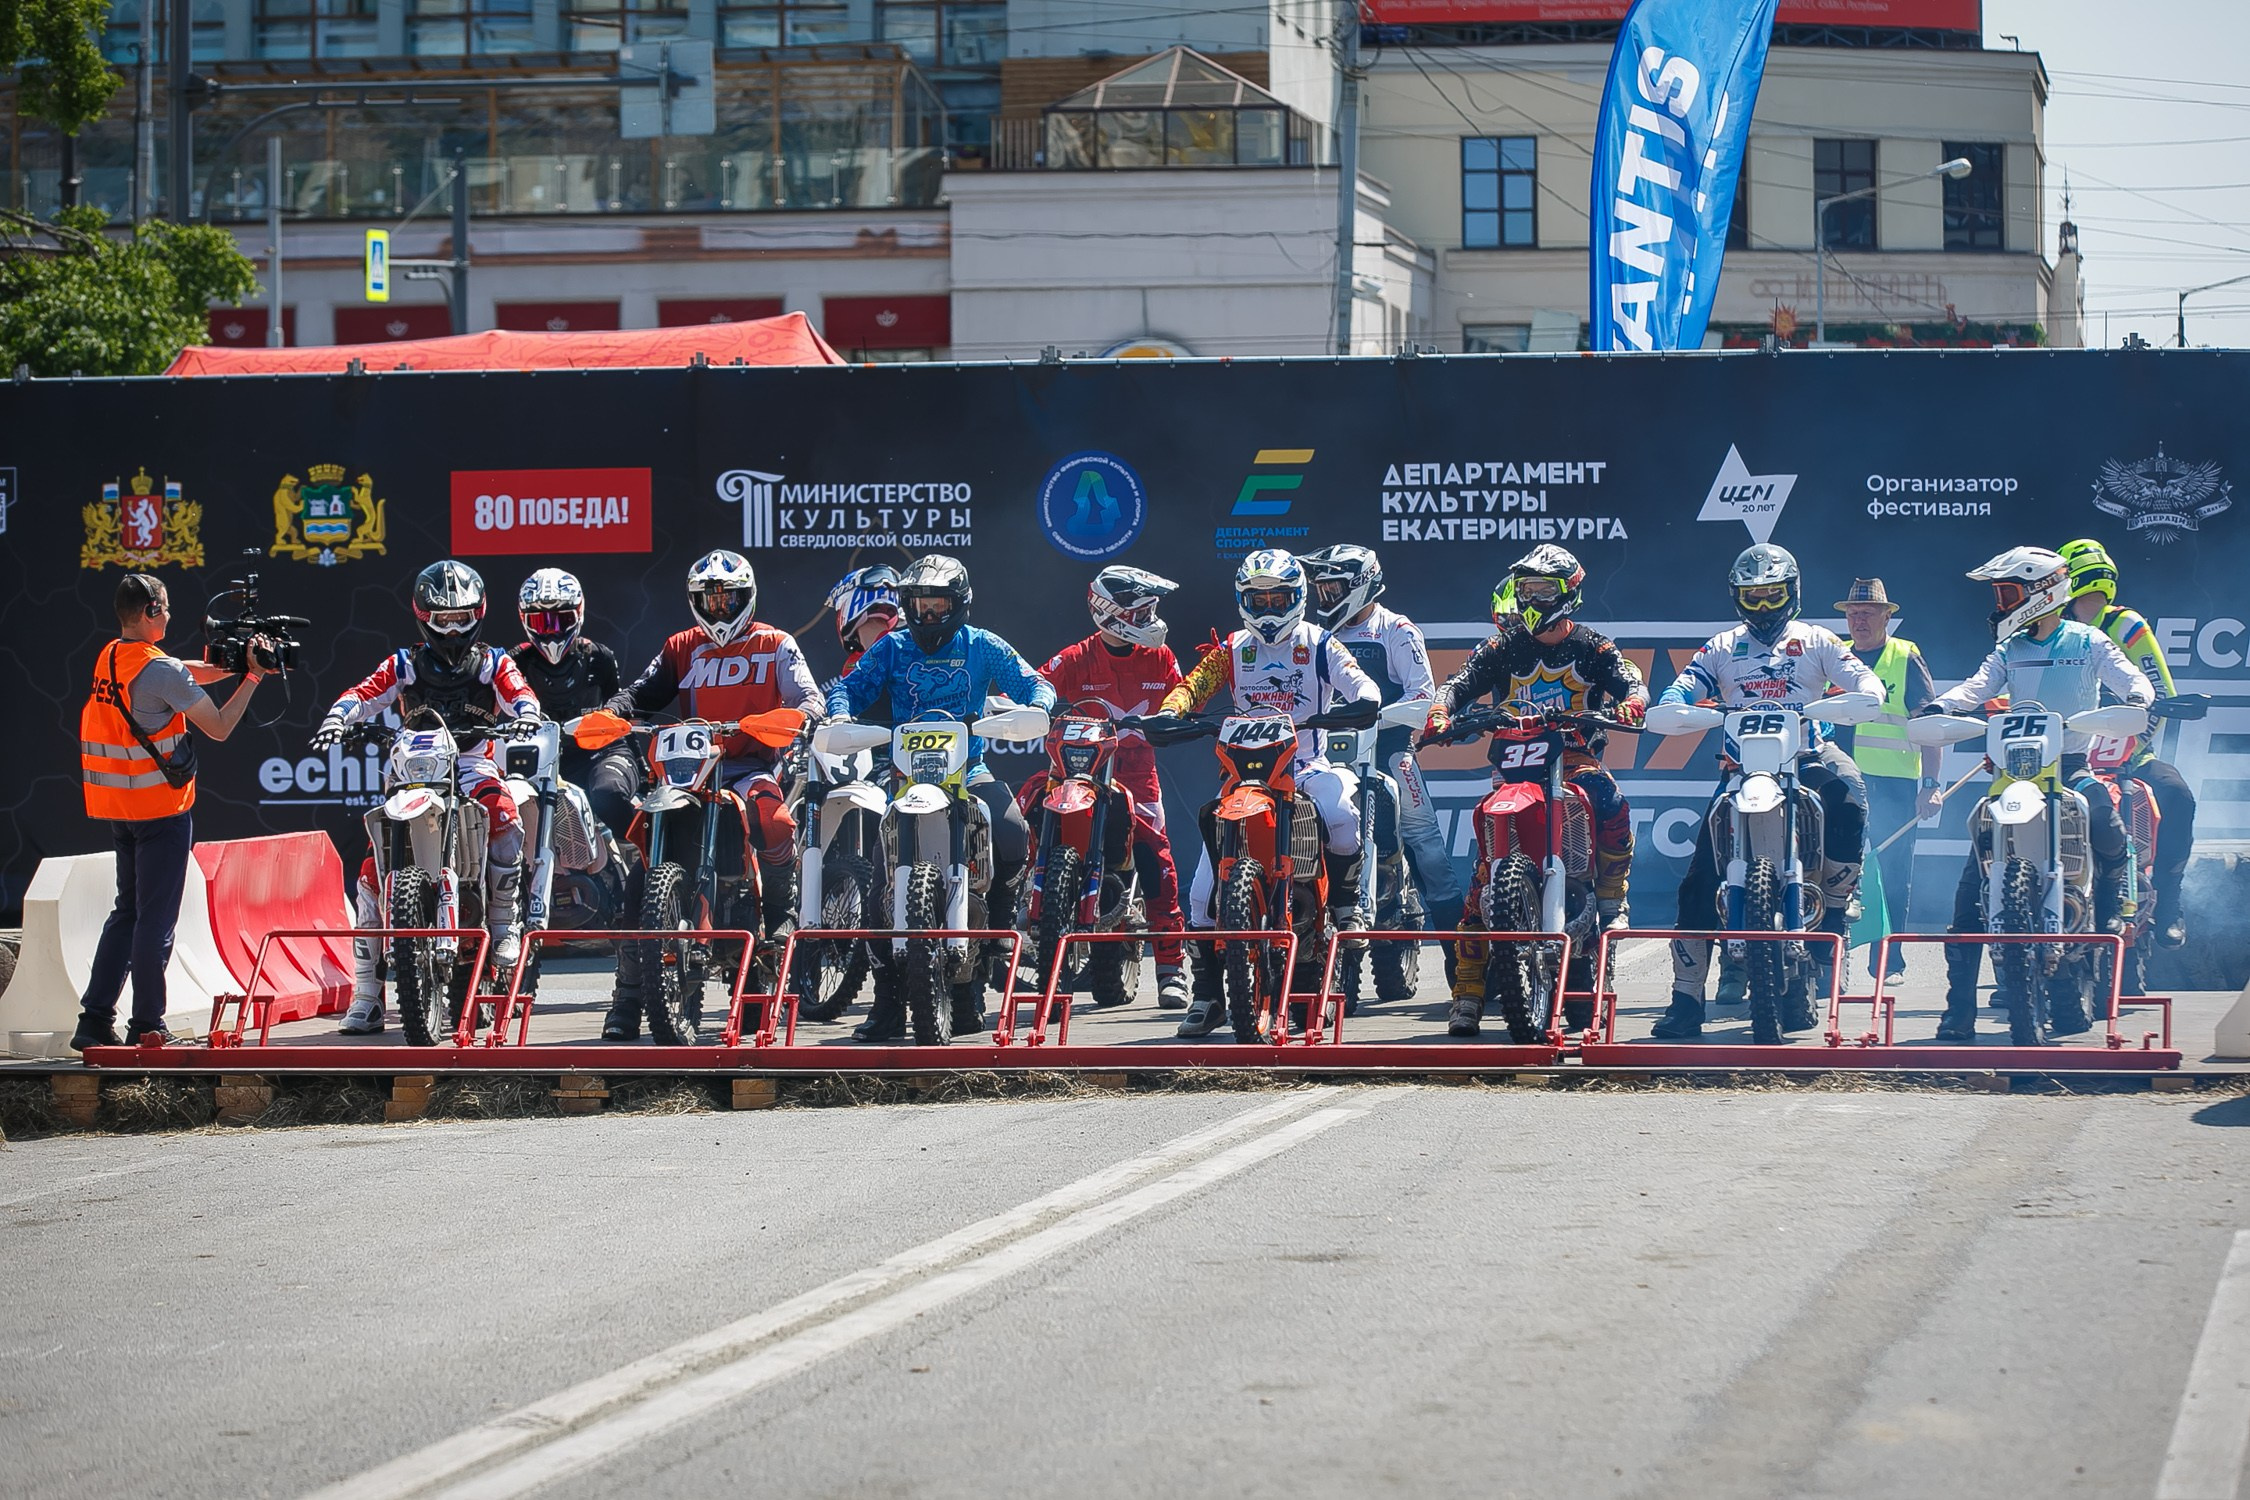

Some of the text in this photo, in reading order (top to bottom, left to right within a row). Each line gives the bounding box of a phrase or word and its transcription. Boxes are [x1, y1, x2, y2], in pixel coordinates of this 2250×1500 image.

[1609, 46, 1700, 350] ANTIS
[1382, 462, 1607, 486] ДЕПАРТАМЕНТ
[779, 483, 972, 504] МИНИСТЕРСТВО
[1866, 474, 2019, 496] Организатор
[474, 494, 629, 531] 80 ПОБЕДА!
[1382, 490, 1547, 514] КУЛЬТУРЫ
[1742, 504, 1755, 513] 20
[1866, 497, 1991, 520] фестиваля
[779, 508, 972, 529] КУЛЬТУРЫ
[2131, 514, 2194, 528] ФЕДЕРАЦИЯ
[779, 531, 972, 549] СВЕРДЛОВСКОЙ ОБЛАСТИ
[1215, 527, 1310, 538] ДЕПАРТАМЕНТ
[1382, 517, 1629, 542] ЕКАТЕРИНБУРГА
[1215, 538, 1267, 548] СПОРТА
[678, 652, 777, 690] MDT
[949, 658, 966, 668] 807
[1141, 682, 1167, 691] THOR
[1733, 674, 1768, 683] МОТОСПОРТ
[1743, 677, 1787, 690] ЮЖНЫЙ
[1251, 690, 1295, 701] ЮЖНЫЙ
[1760, 689, 1787, 700] УРАЛ
[1062, 724, 1103, 742] 54
[1228, 722, 1283, 745] 444
[1737, 714, 1785, 737] 86
[2001, 715, 2049, 740] 26
[662, 730, 706, 753] 16
[907, 734, 953, 751] 807
[1501, 742, 1550, 770] 32
[345, 796, 368, 806] est.
